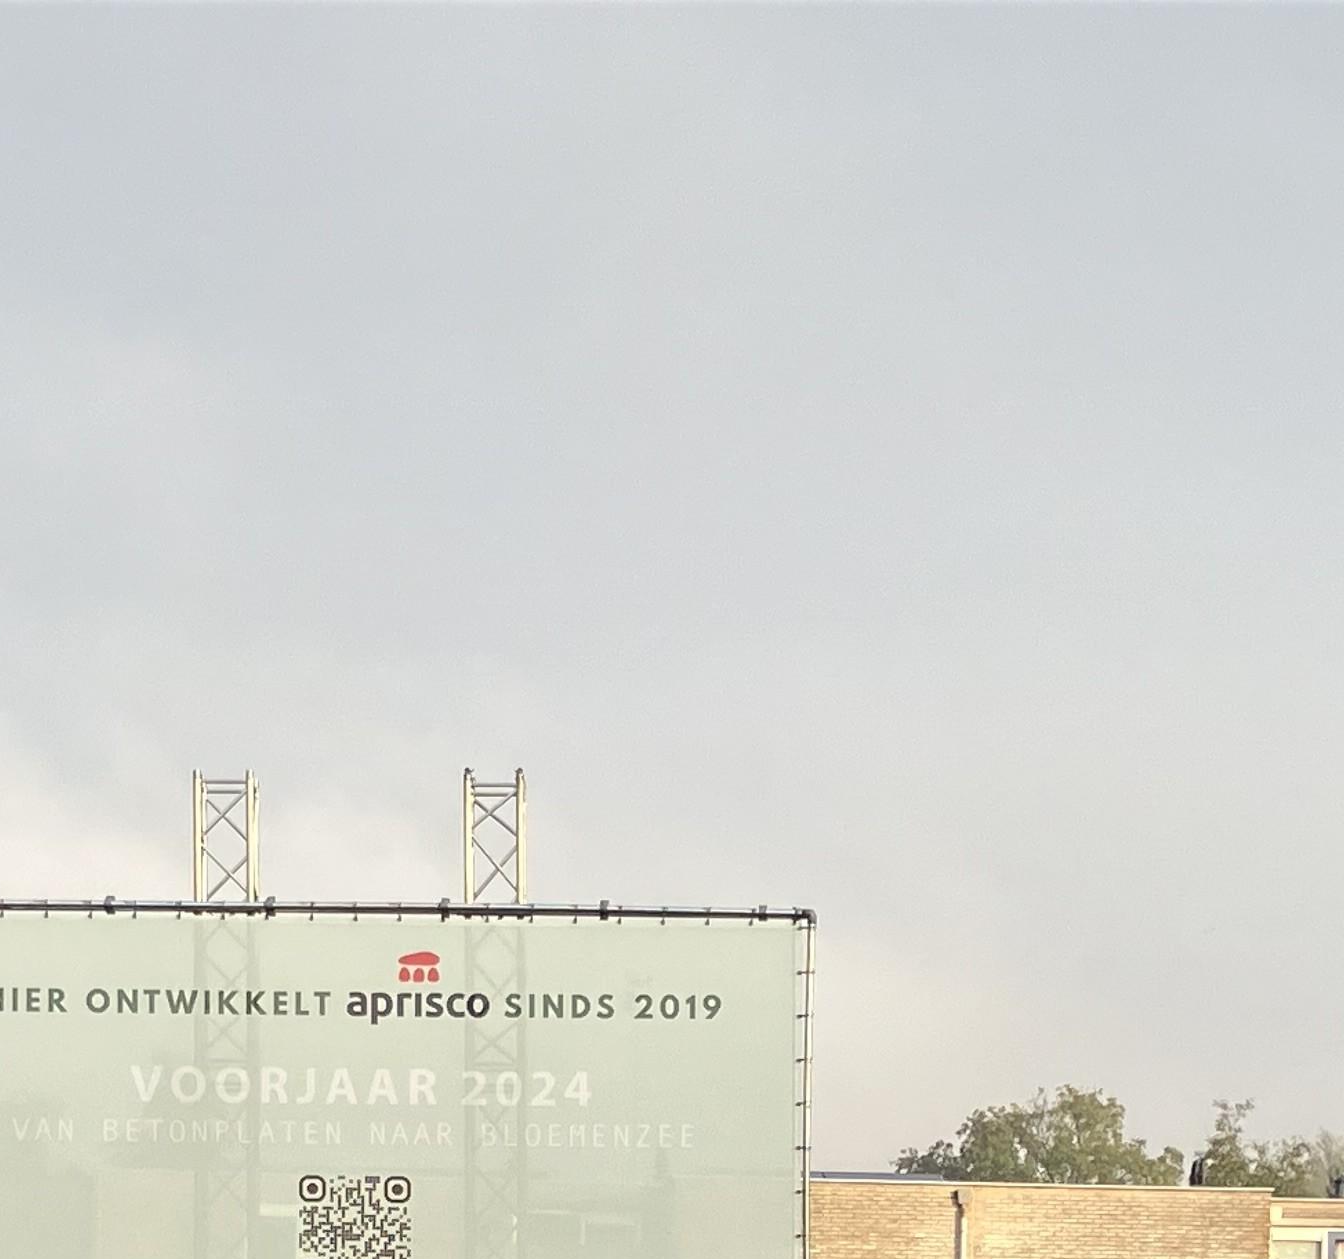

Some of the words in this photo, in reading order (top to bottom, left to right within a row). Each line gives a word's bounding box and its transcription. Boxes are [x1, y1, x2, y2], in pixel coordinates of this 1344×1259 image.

[86, 988, 331, 1016] ONTWIKKELT
[346, 991, 490, 1025] aprisco
[504, 993, 615, 1019] SINDS
[633, 993, 722, 1020] 2019
[130, 1065, 437, 1105] VOORJAAR
[460, 1070, 593, 1107] 2024
[12, 1117, 74, 1142] VAN
[103, 1118, 342, 1145] BETONPLATEN
[369, 1121, 453, 1147] NAAR
[481, 1123, 695, 1149] BLOEMENZEE
